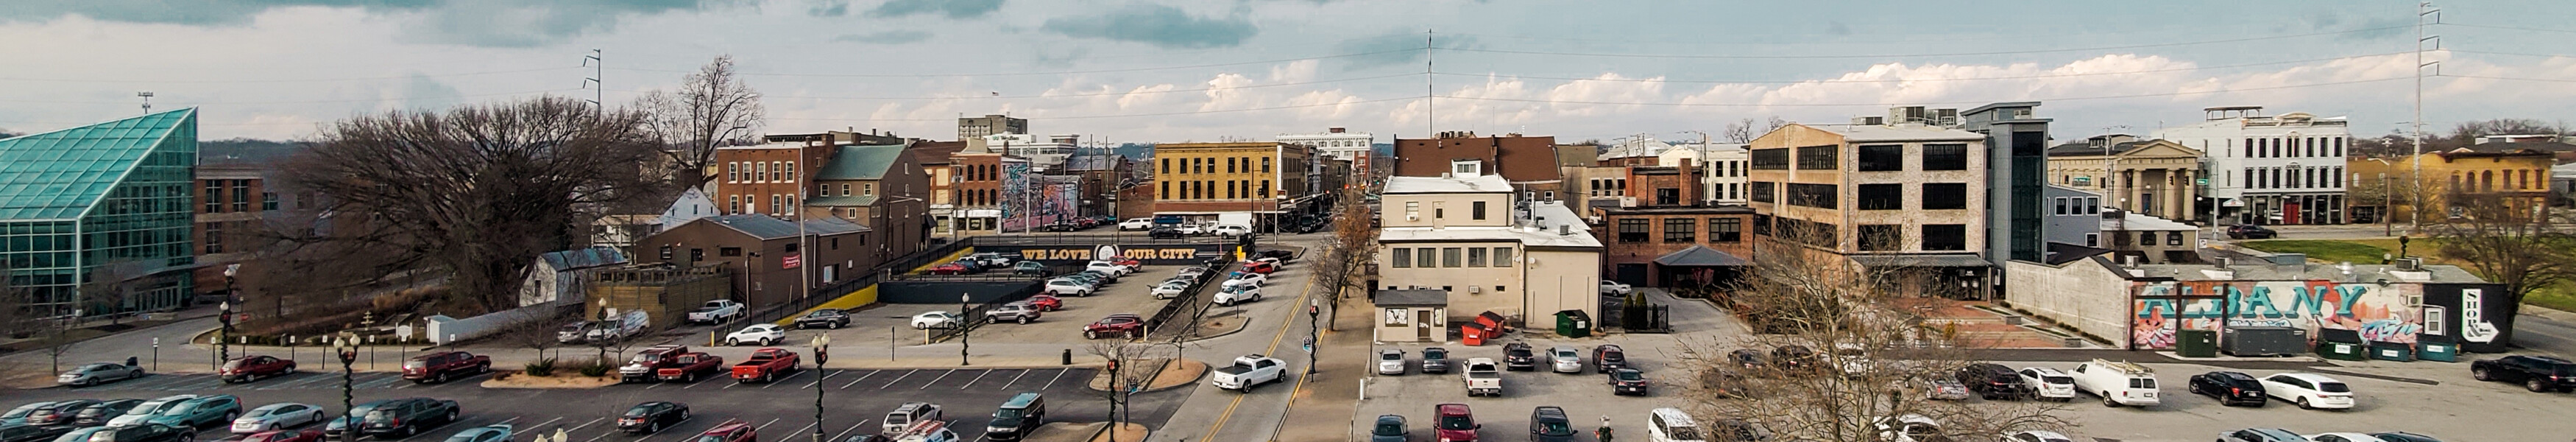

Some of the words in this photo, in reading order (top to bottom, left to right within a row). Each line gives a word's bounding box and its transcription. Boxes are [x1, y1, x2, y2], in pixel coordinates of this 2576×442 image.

[1022, 249, 1046, 260] WE
[1050, 249, 1090, 259] LOVE
[1124, 249, 1156, 259] OUR
[1159, 248, 1195, 260] CITY
[2138, 286, 2367, 318] ALBANY
[2467, 291, 2477, 326] SHOP
